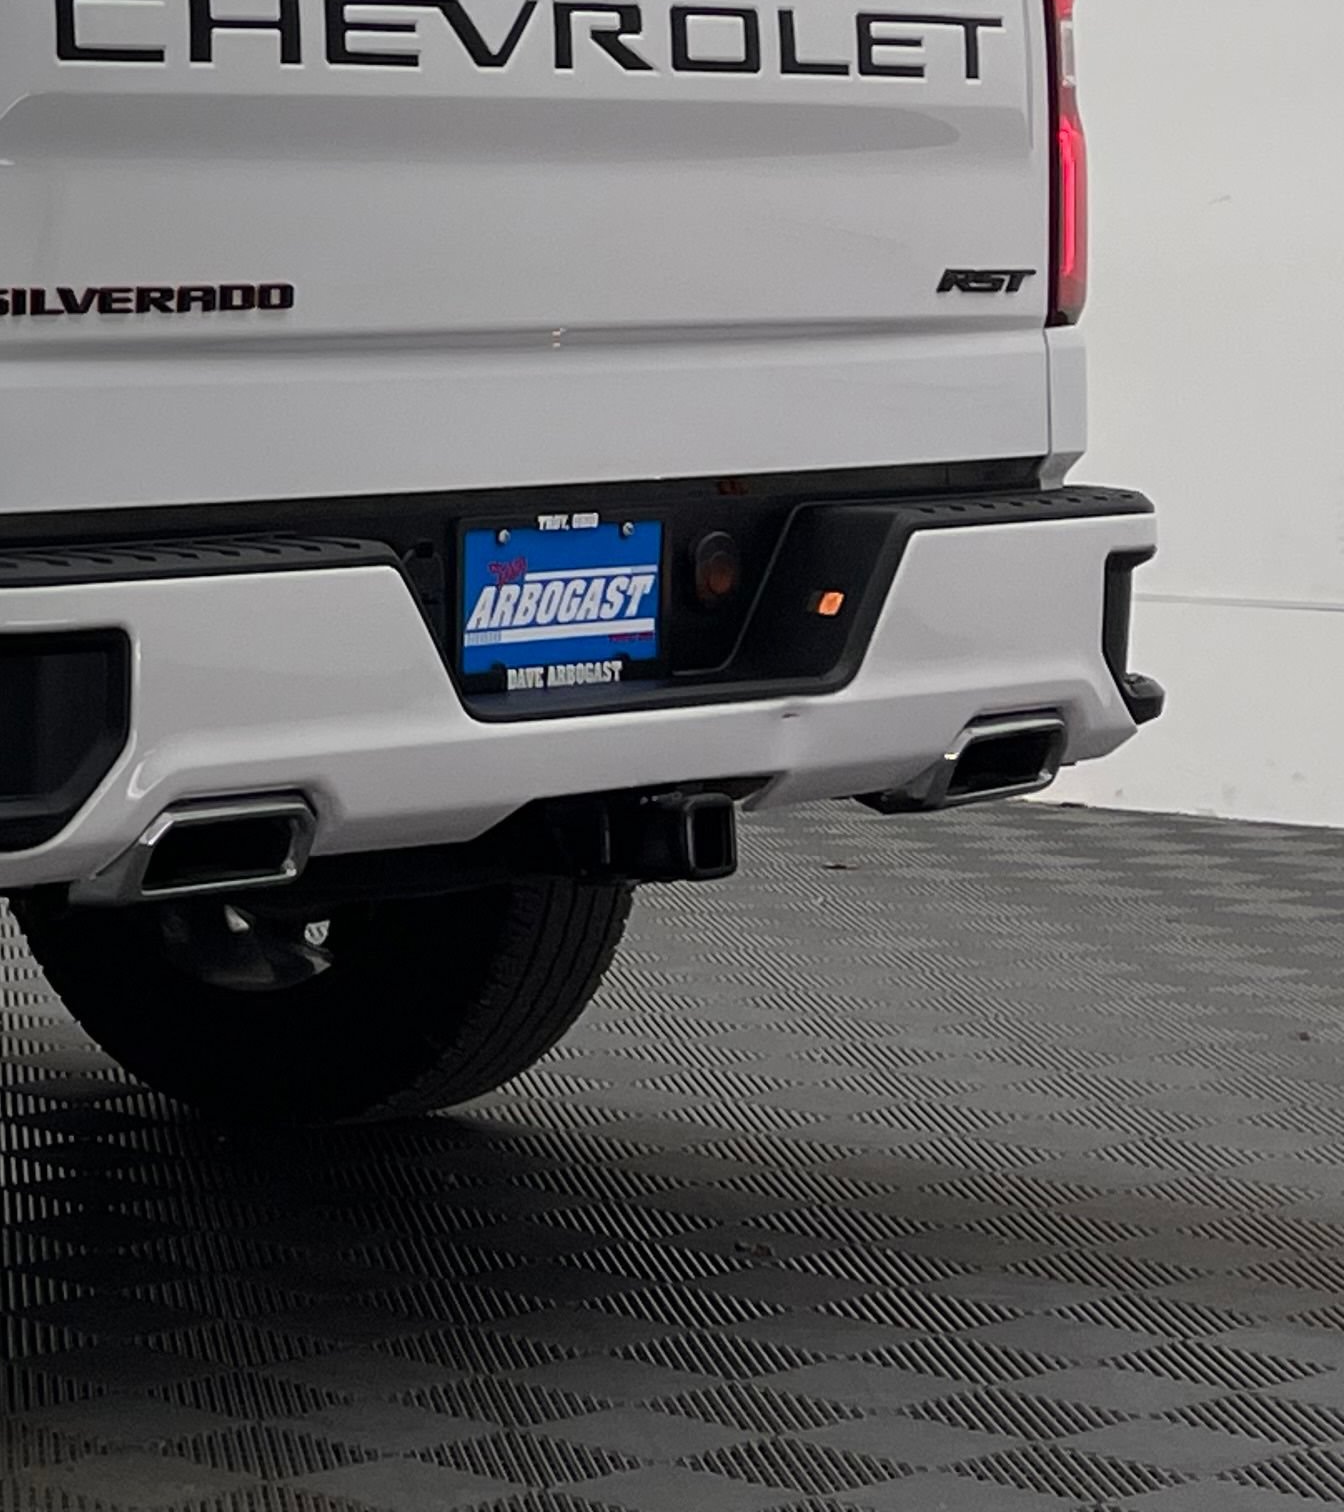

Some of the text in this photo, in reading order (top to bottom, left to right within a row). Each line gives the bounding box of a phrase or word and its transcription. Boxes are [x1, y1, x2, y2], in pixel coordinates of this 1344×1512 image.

[936, 268, 1037, 293] RST
[466, 575, 656, 631] ARBOGAST
[507, 660, 623, 690] DAVE ARBOGAST
